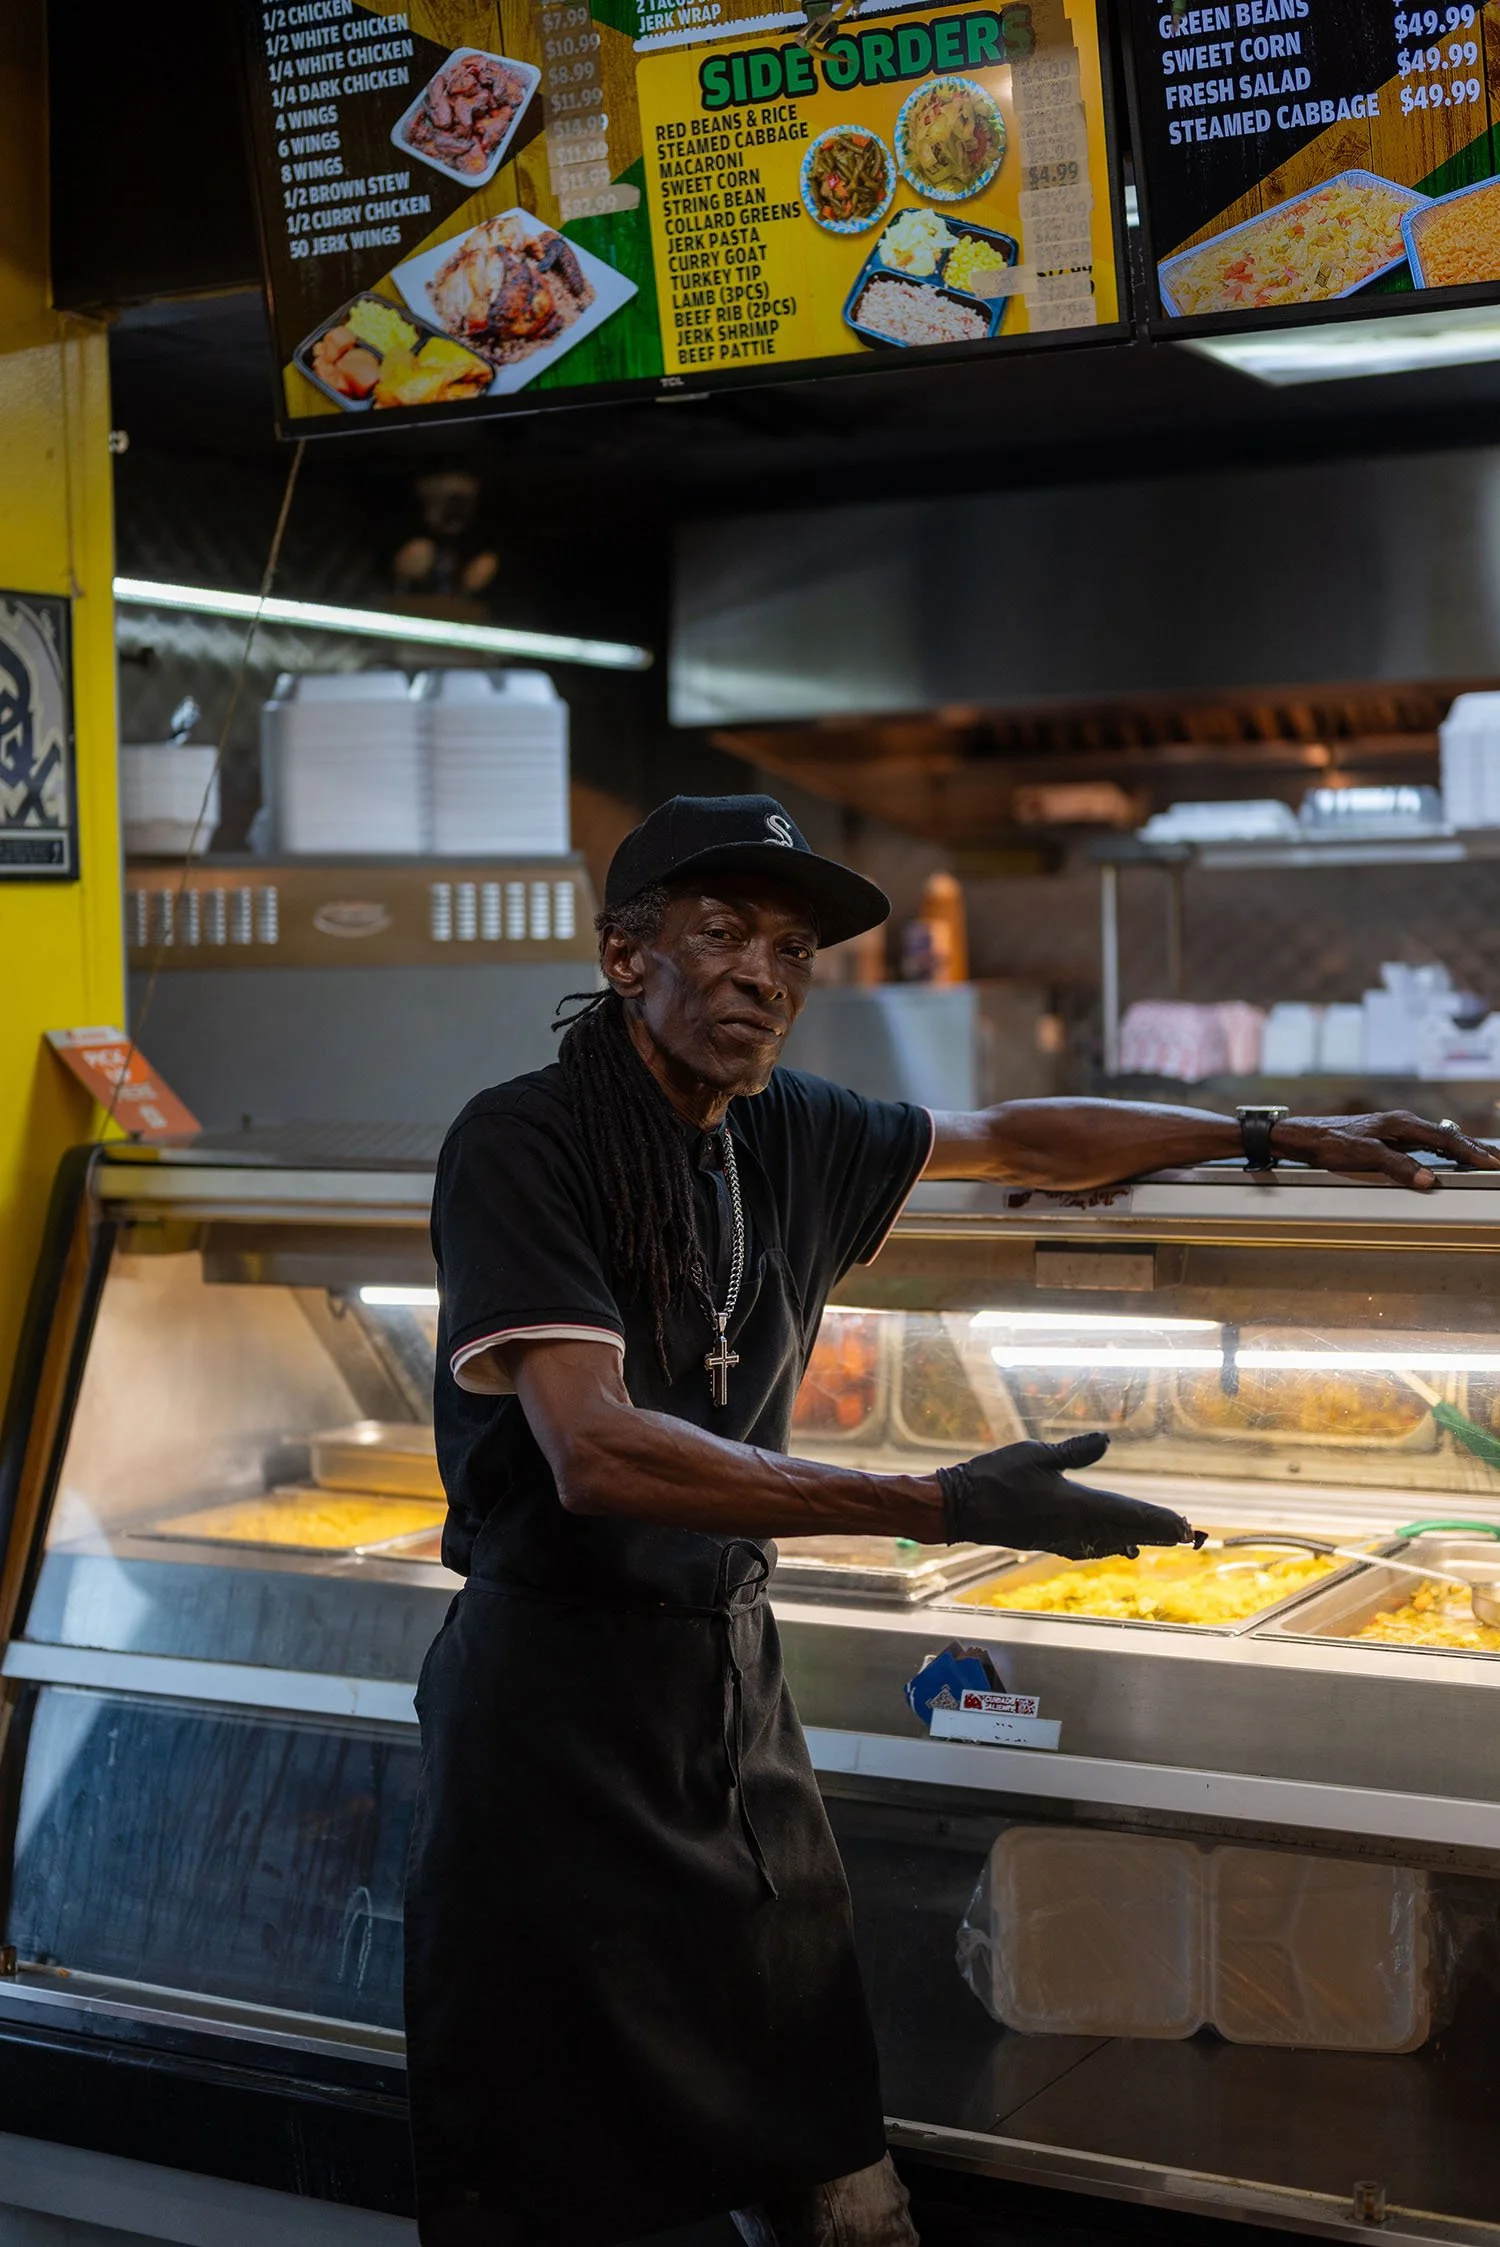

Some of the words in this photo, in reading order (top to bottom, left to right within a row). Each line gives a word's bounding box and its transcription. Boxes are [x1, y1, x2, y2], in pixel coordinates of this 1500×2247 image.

[262, 10, 286, 31] 1/2
[288, 0, 353, 24] CHICKEN
[542, 8, 588, 33] $7.99
[636, 0, 646, 14] 2
[638, 12, 674, 33] JERK
[676, 4, 721, 25] WRAP
[1159, 6, 1231, 40] GREEN
[1236, 0, 1309, 28] BEANS
[265, 35, 290, 57] 1/2
[291, 26, 340, 50] WHITE
[342, 14, 409, 40] CHICKEN
[1394, 4, 1475, 44] $49.99
[268, 60, 294, 83] 1/4
[296, 51, 346, 76] WHITE
[348, 40, 414, 66] CHICKEN
[546, 34, 600, 60] $10.99
[702, 46, 815, 108] SIDE
[823, 6, 1031, 87] ORDERS
[1162, 42, 1235, 76] SWEET
[1240, 31, 1302, 63] CORN
[1397, 42, 1477, 80] $49.99
[272, 87, 298, 108] 1/4
[299, 78, 342, 102] DARK
[344, 67, 410, 94] CHICKEN
[549, 62, 594, 86] $8.99
[1166, 78, 1234, 110] FRESH
[1239, 67, 1311, 99] SALAD
[552, 88, 602, 114] $11.99
[1400, 78, 1481, 116] $49.99
[276, 114, 286, 132] 4
[288, 106, 338, 130] WINGS
[656, 122, 686, 142] RED
[691, 112, 742, 136] BEANS
[746, 109, 757, 127] &
[762, 104, 798, 124] RICE
[1168, 109, 1271, 145] STEAMED
[1276, 93, 1380, 130] CABBAGE
[278, 140, 288, 158] 6
[290, 132, 341, 156] WINGS
[658, 134, 730, 160] STEAMED
[734, 122, 808, 148] CABBAGE
[282, 166, 292, 183] 8
[292, 156, 343, 180] WINGS
[659, 152, 744, 178] MACARONI
[1029, 162, 1078, 184] $4.99
[284, 188, 307, 210] 1/2
[308, 179, 367, 204] BROWN
[368, 172, 410, 195] STEW
[662, 176, 714, 198] SWEET
[716, 169, 760, 190] CORN
[287, 213, 312, 234] 1/2
[312, 204, 362, 229] CURRY
[364, 195, 432, 222] CHICKEN
[664, 194, 720, 217] STRING
[724, 188, 766, 208] BEAN
[666, 212, 734, 235] COLLARD
[740, 202, 800, 224] GREENS
[290, 240, 308, 259] 50
[312, 234, 349, 256] JERK
[350, 226, 401, 250] WINGS
[668, 234, 704, 254] JERK
[710, 228, 760, 248] PASTA
[670, 252, 720, 273] CURRY
[726, 244, 766, 266] GOAT
[672, 268, 732, 290] TURKEY
[736, 264, 761, 282] TIP
[672, 289, 716, 309] LAMB
[720, 281, 770, 305] (3PCS)
[675, 310, 711, 328] BEEF
[716, 304, 743, 323] RIB
[747, 297, 796, 320] (2PCS)
[678, 326, 714, 347] JERK
[718, 320, 779, 342] SHRIMP
[679, 346, 715, 365] BEEF
[720, 339, 776, 360] PATTIE
